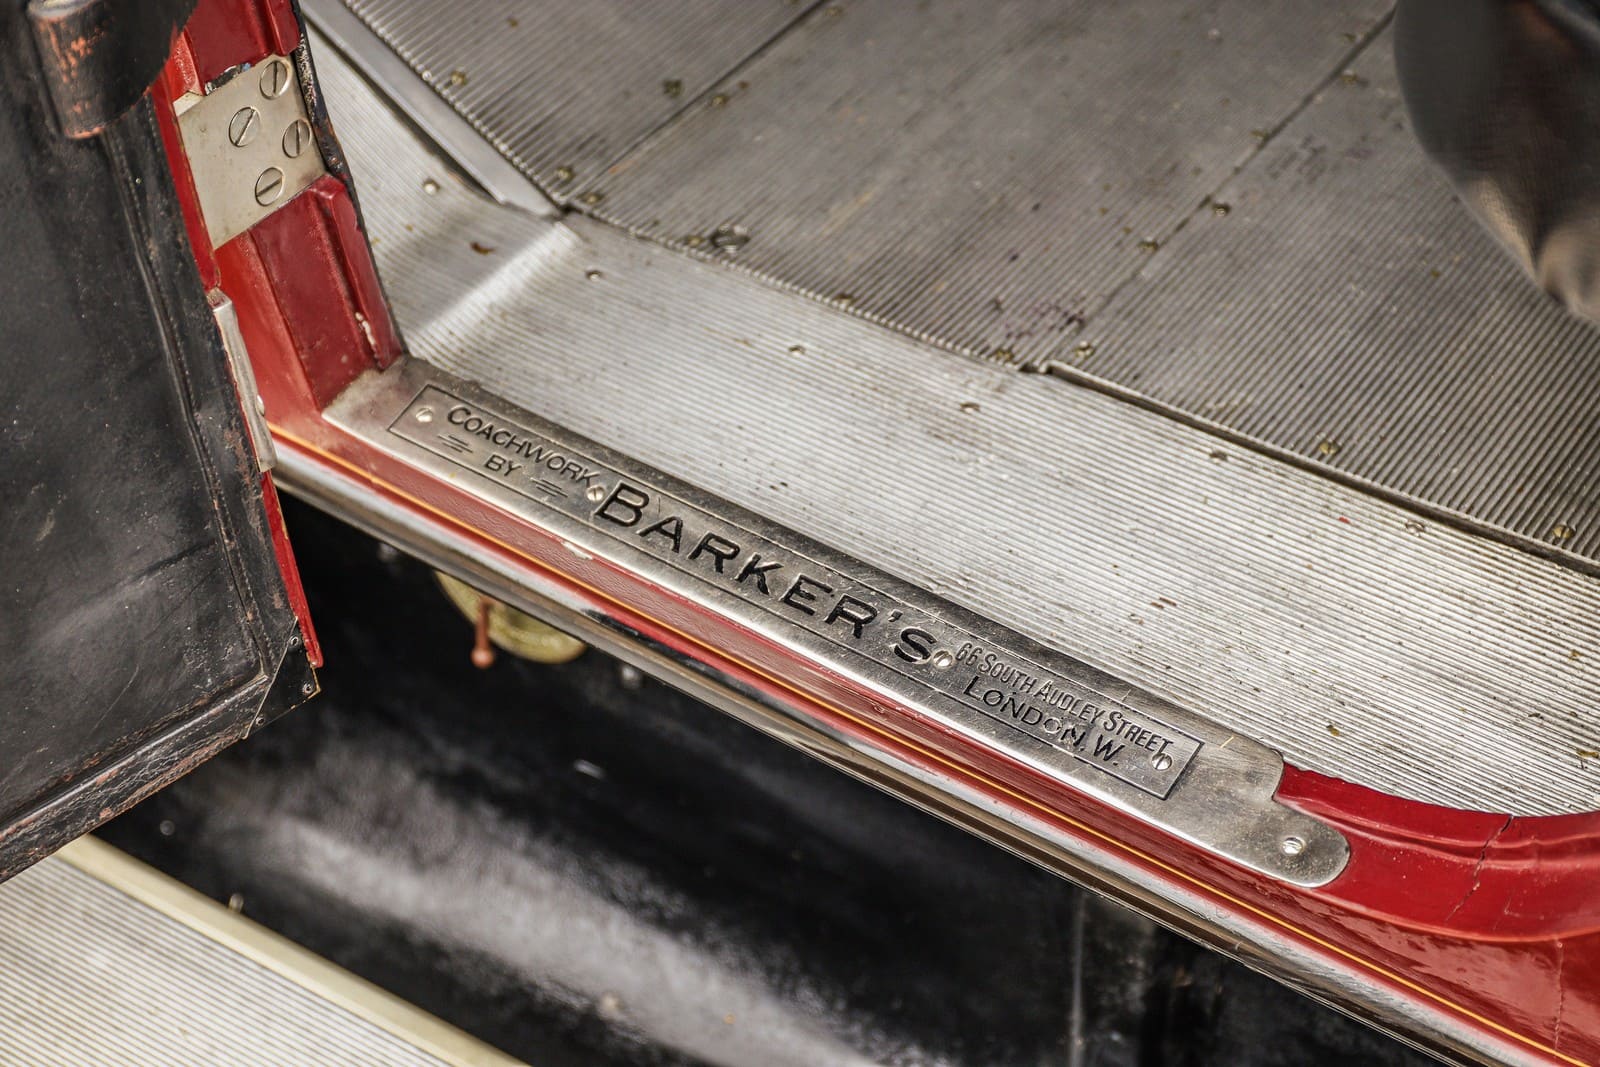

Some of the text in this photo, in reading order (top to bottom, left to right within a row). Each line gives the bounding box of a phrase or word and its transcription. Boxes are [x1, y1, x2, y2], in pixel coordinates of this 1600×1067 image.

[446, 404, 600, 489] COACHWORK
[483, 453, 522, 478] BY
[593, 480, 937, 665] BARKER'S
[955, 641, 1174, 754] 66 SOUTH AUDLEY STREET
[1094, 733, 1126, 767] W.
